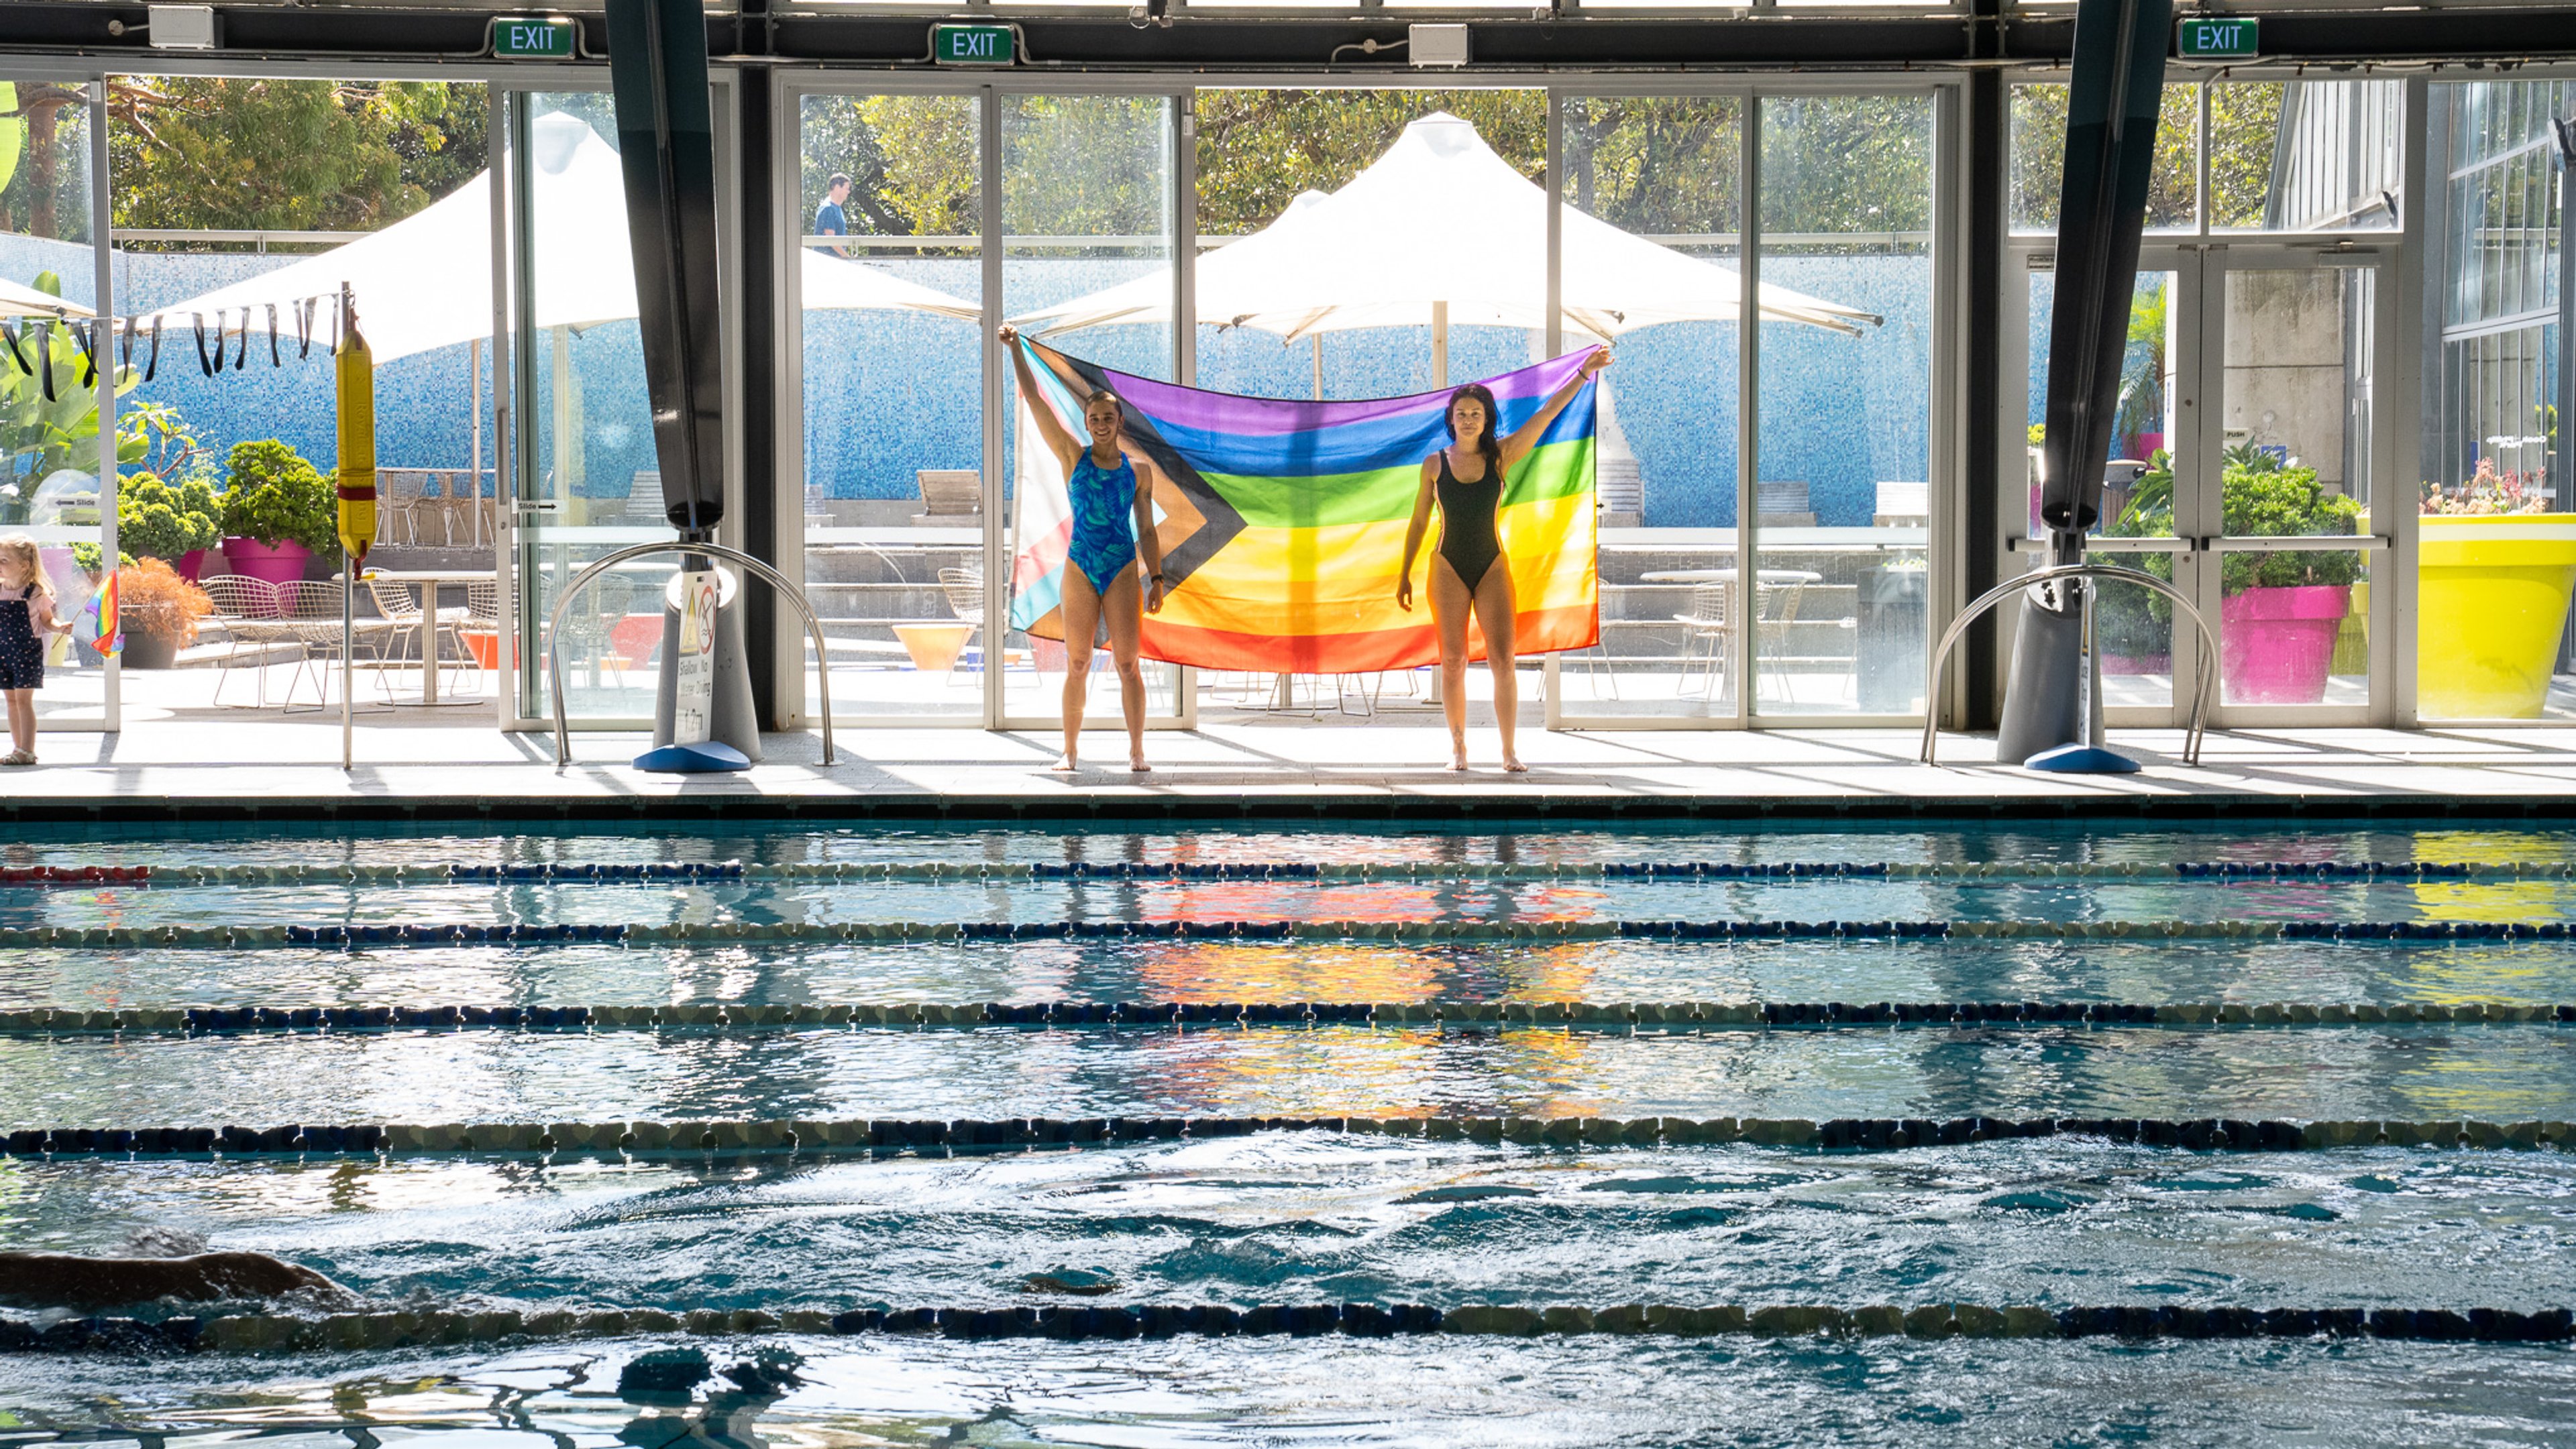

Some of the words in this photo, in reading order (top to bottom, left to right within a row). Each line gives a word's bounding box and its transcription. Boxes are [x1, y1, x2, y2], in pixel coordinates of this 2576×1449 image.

[511, 26, 555, 50] EXIT
[953, 32, 997, 56] EXIT
[2197, 26, 2242, 50] EXIT
[680, 660, 697, 676] Shallow
[701, 659, 708, 672] No
[696, 679, 710, 696] Diving
